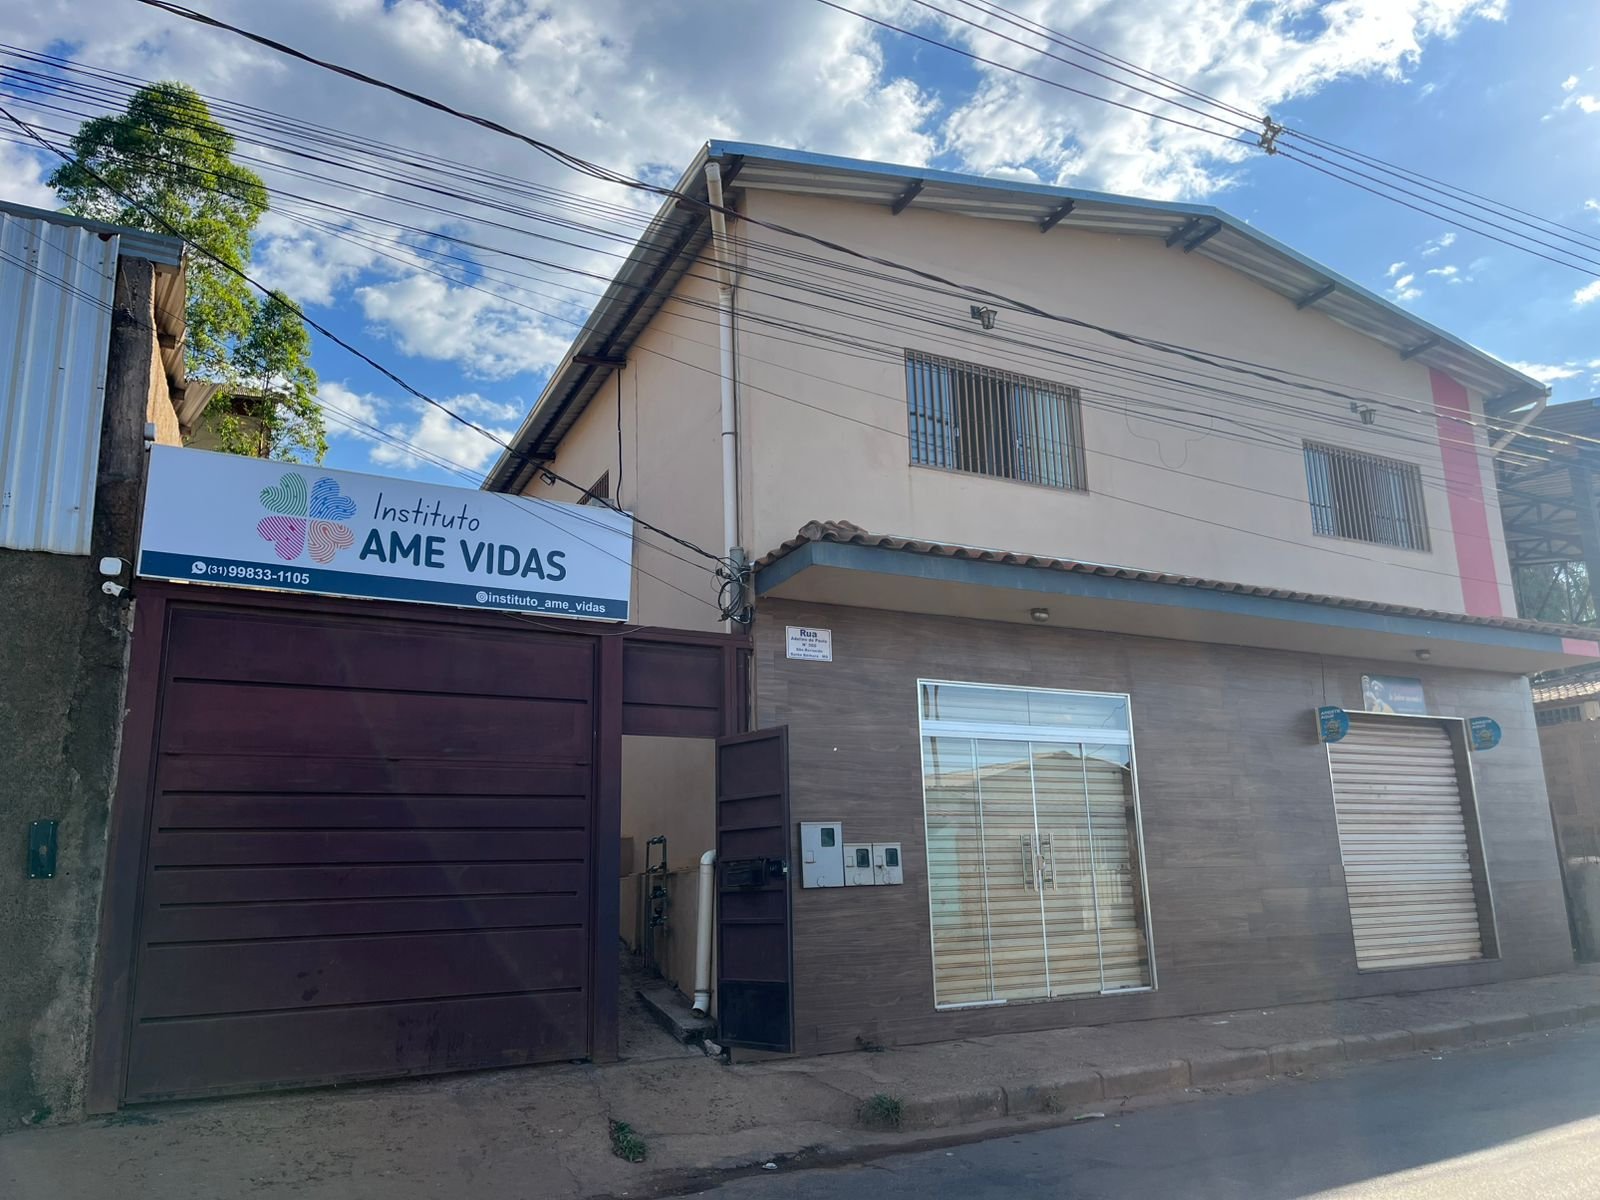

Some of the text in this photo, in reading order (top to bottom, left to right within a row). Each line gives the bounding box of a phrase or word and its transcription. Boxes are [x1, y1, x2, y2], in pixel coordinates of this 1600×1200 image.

[373, 492, 480, 532] Instituto
[359, 528, 567, 582] AME VIDAS
[800, 629, 817, 638] Rua
